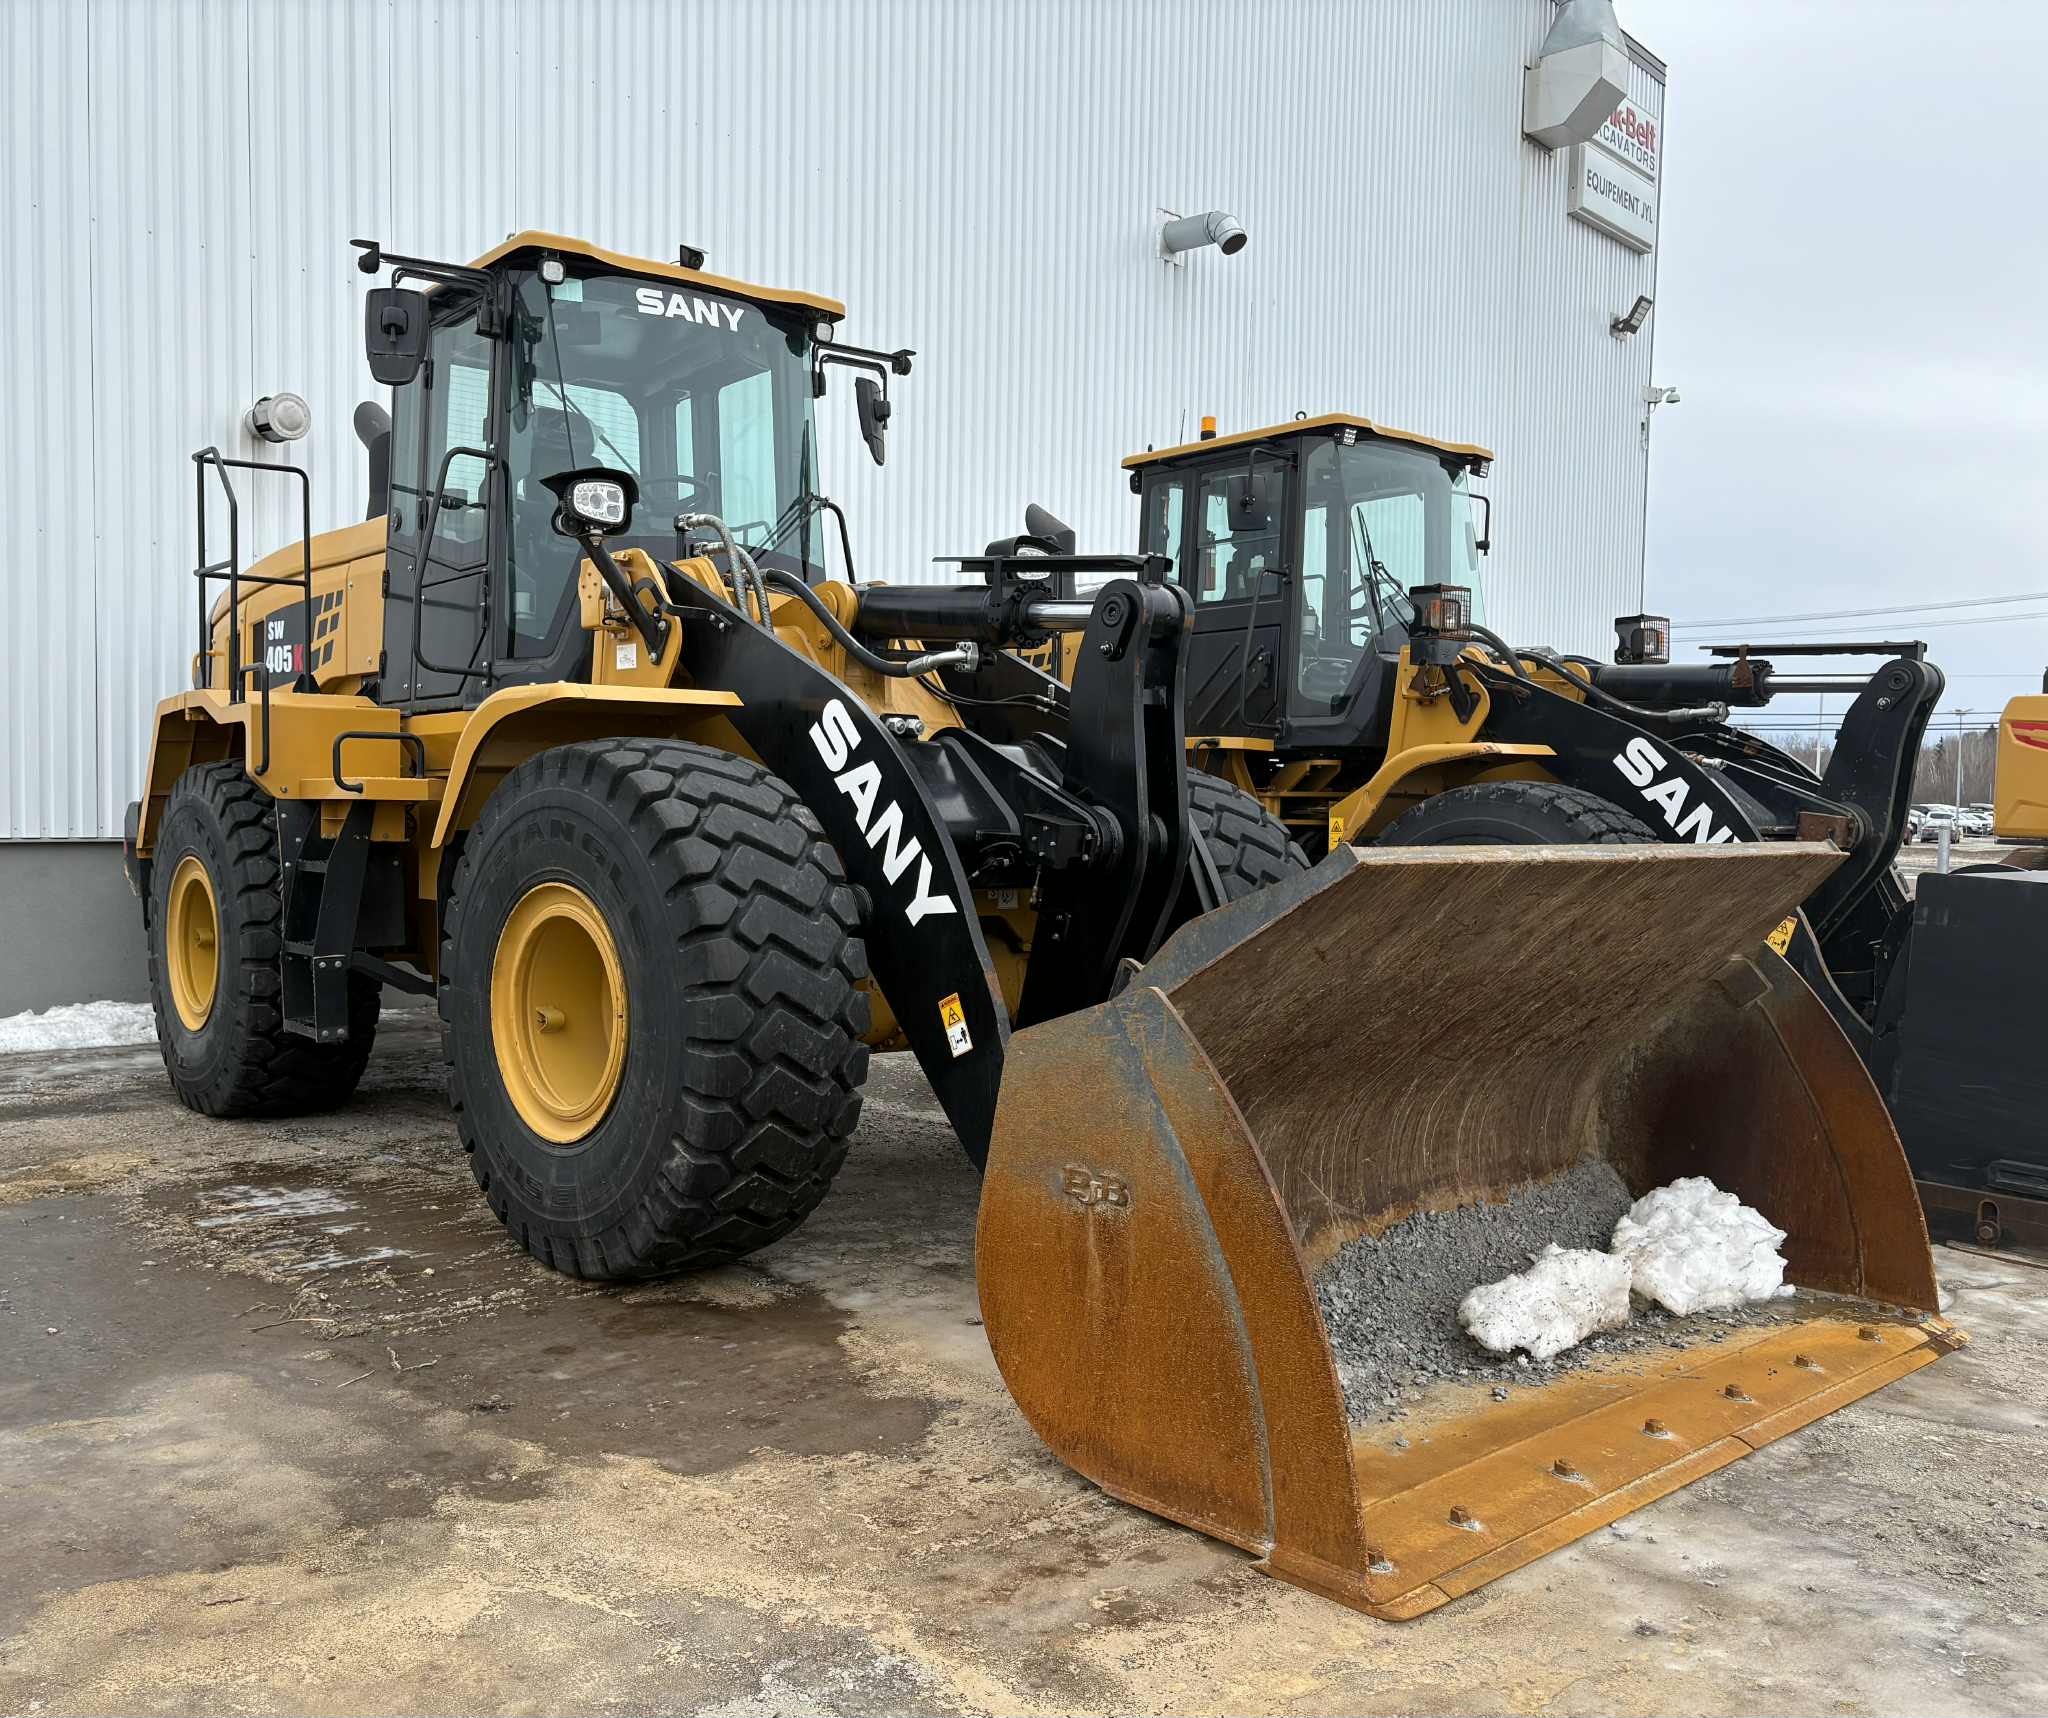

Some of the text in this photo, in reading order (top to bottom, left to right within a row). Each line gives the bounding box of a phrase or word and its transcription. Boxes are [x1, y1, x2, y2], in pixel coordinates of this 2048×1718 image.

[1600, 125, 1655, 171] CAVATORS
[1610, 106, 1656, 154] k-Belt
[1587, 169, 1653, 224] EQUIPEMENT JYL
[635, 287, 745, 332] SANY
[268, 620, 285, 640] SW
[266, 644, 304, 673] 405K
[808, 698, 957, 927] SANY
[1612, 737, 1744, 844] SAN
